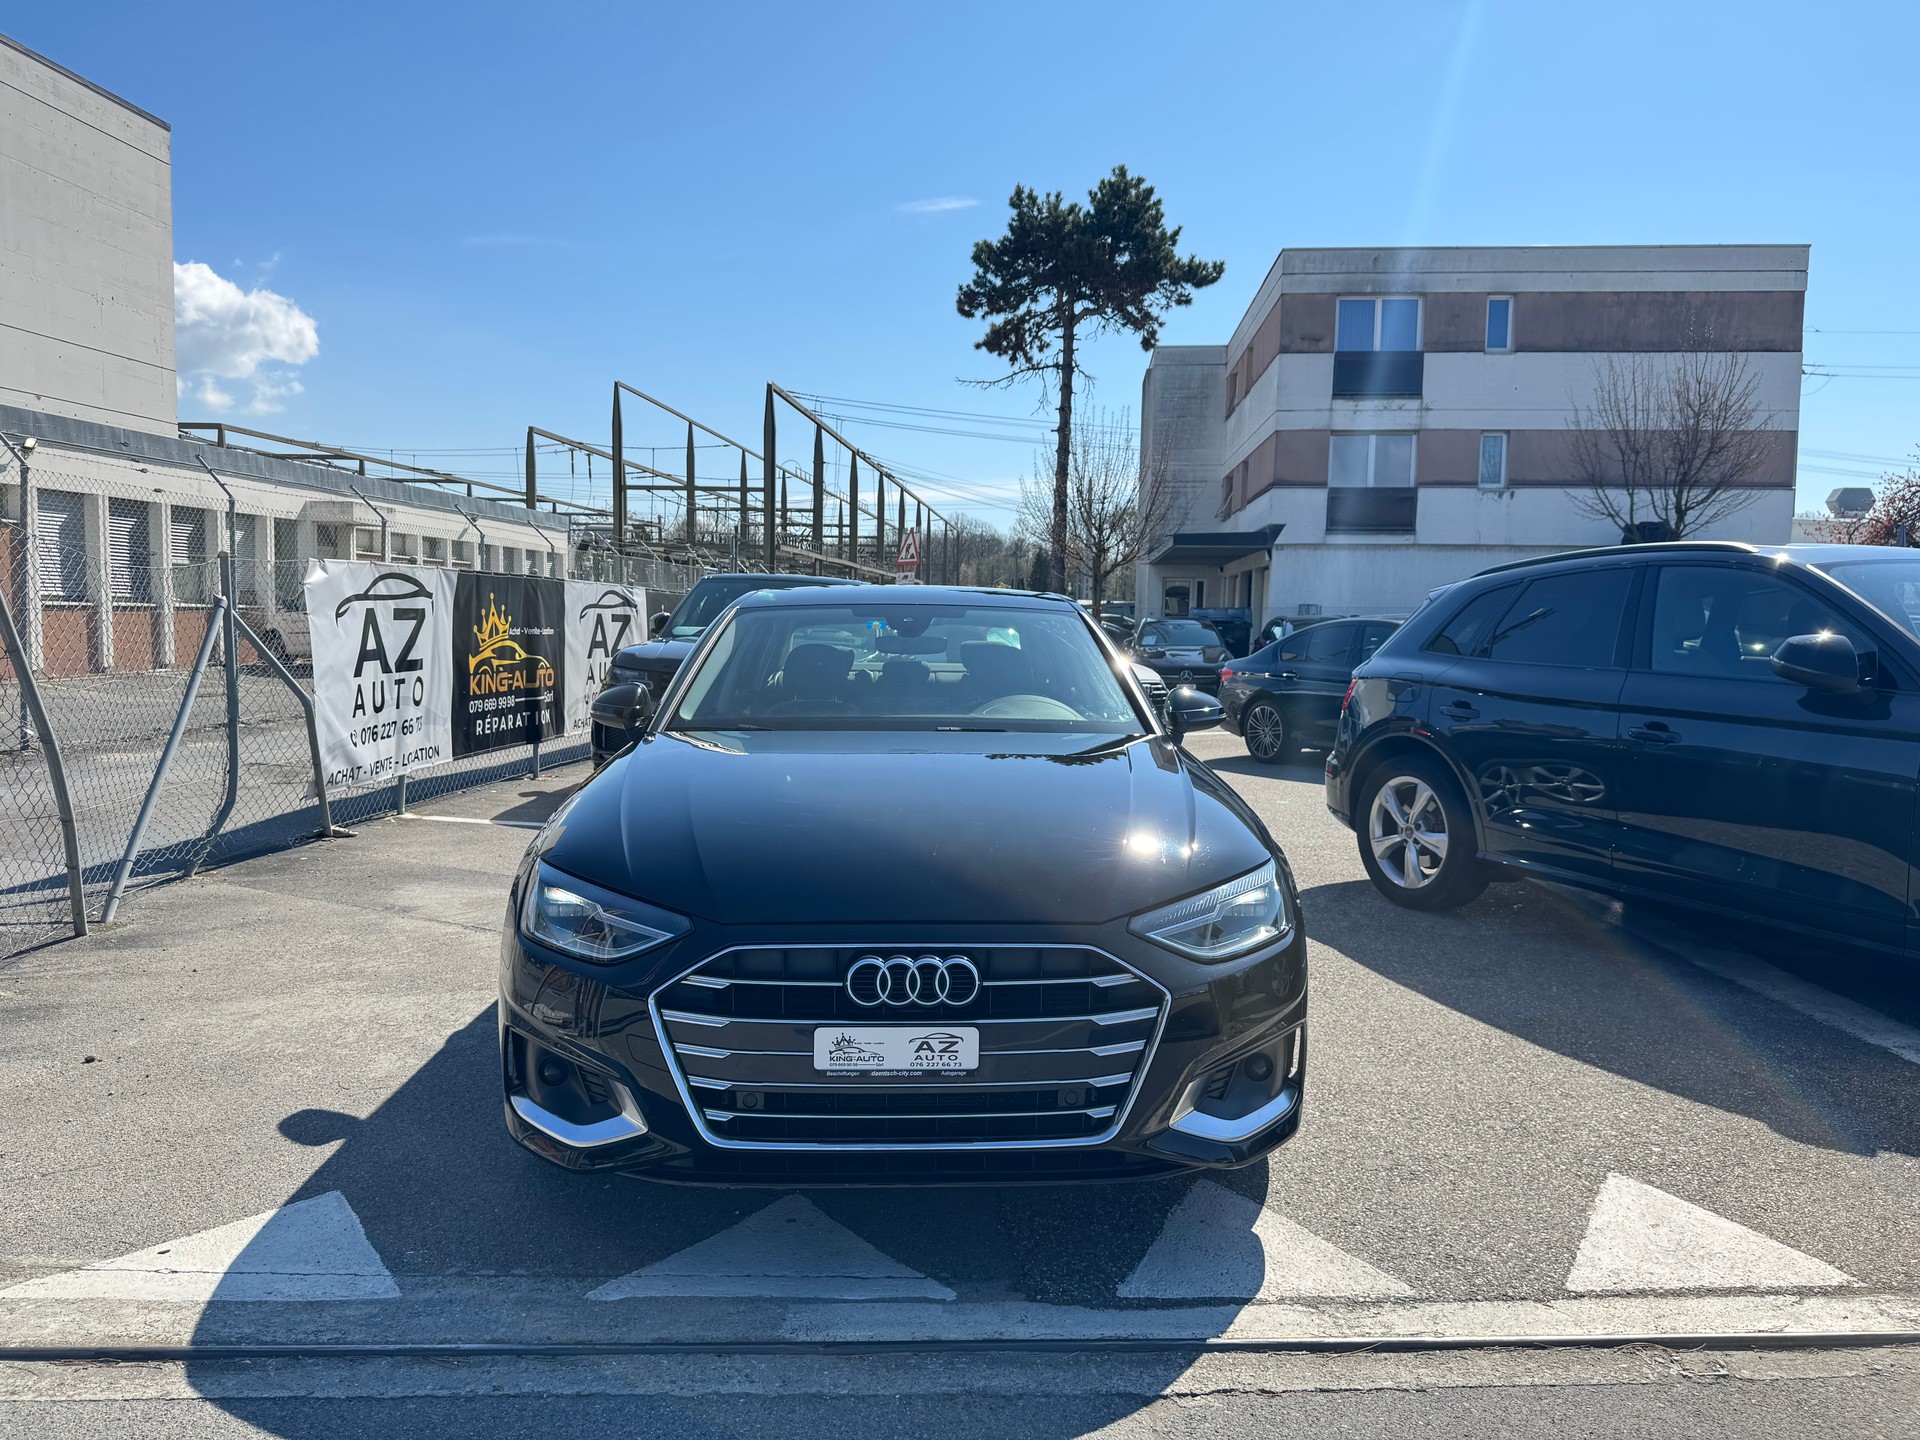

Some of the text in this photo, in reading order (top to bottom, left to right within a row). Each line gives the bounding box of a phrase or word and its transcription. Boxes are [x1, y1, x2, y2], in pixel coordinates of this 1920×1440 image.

[353, 607, 426, 678] AZ
[587, 613, 631, 659] AZ
[586, 662, 607, 685] AU
[352, 676, 424, 718] AUTO
[469, 700, 483, 714] 079
[484, 697, 497, 711] 669
[360, 724, 379, 746] 076
[380, 720, 398, 740] 227
[401, 718, 414, 736] 66
[476, 709, 551, 736] RÉPARATION
[573, 716, 592, 729] ACHAT
[325, 765, 363, 787] ACHAT
[369, 756, 393, 776] VENTE
[914, 1041, 959, 1053] AZ
